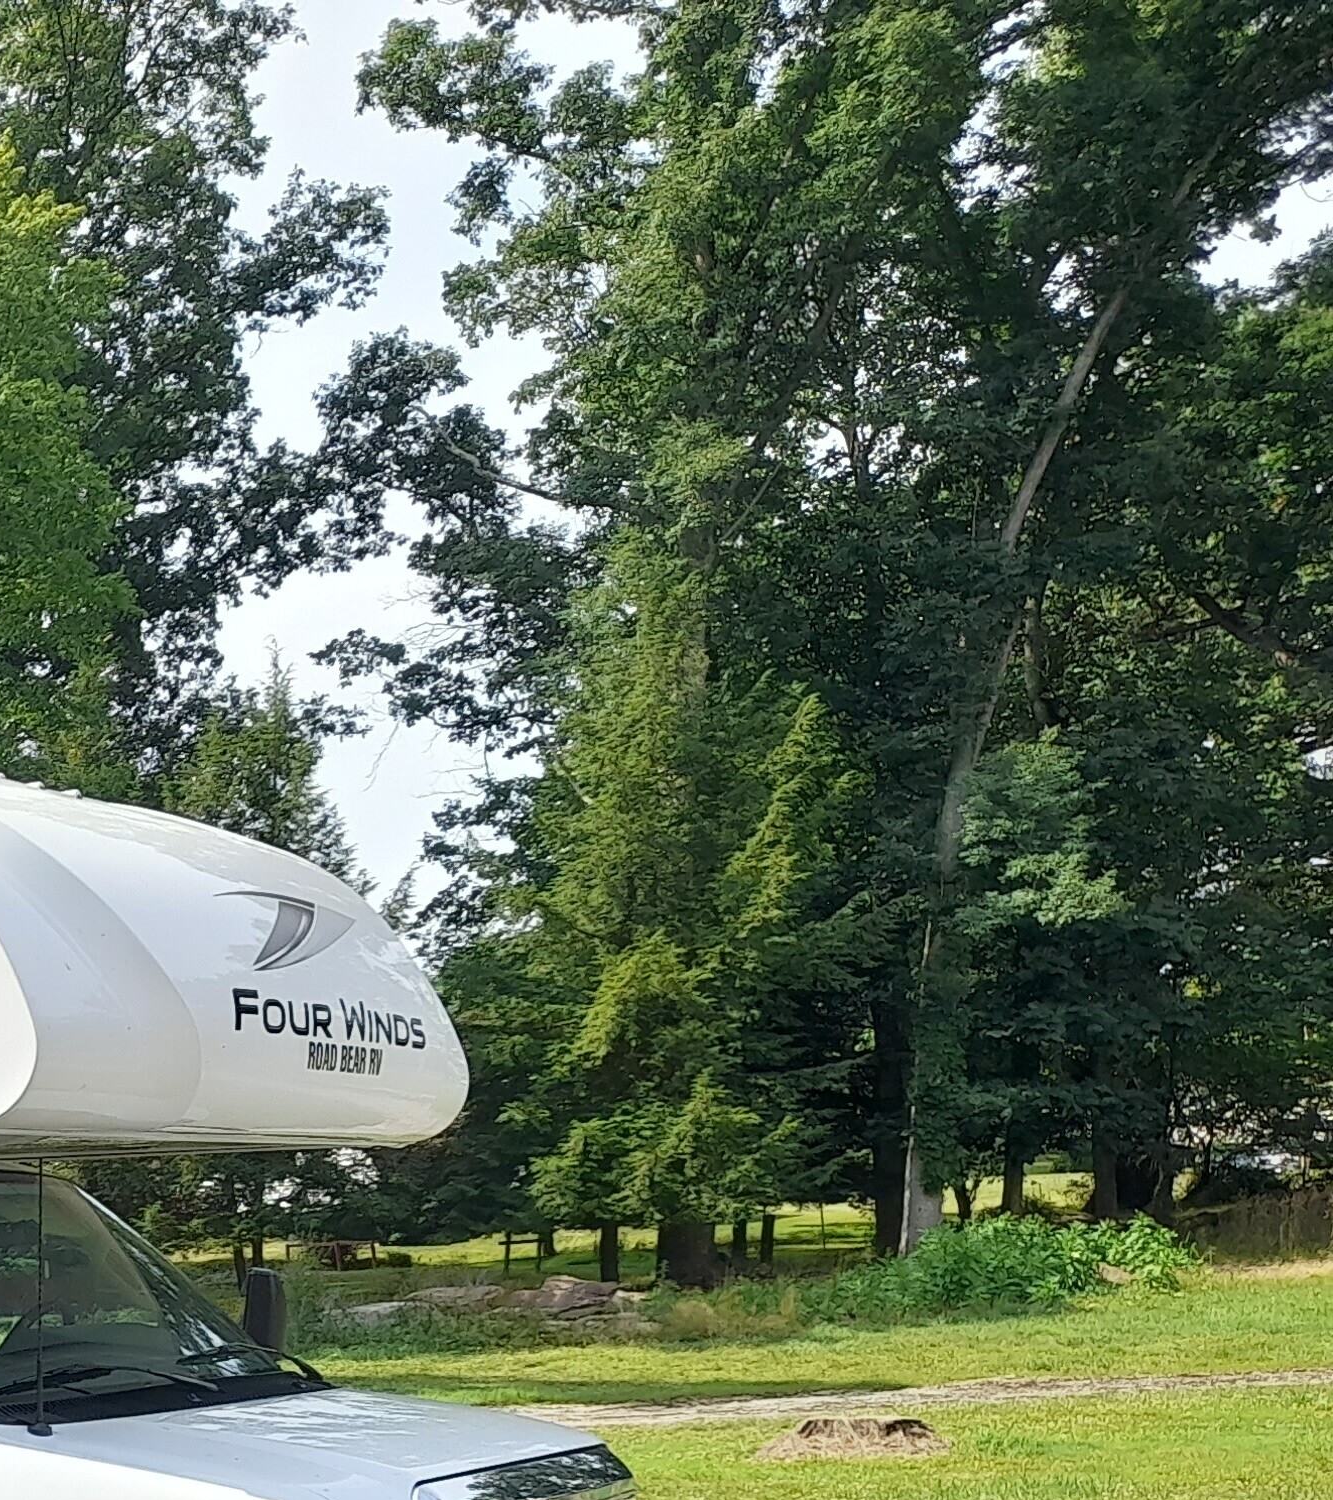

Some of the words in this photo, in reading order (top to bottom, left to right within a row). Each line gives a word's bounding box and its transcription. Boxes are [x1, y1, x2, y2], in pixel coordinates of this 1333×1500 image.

[232, 988, 333, 1038] FOUR
[338, 997, 426, 1049] WINDS
[307, 1041, 338, 1071] ROAD
[339, 1044, 367, 1074] BEAR
[368, 1047, 383, 1076] RV
